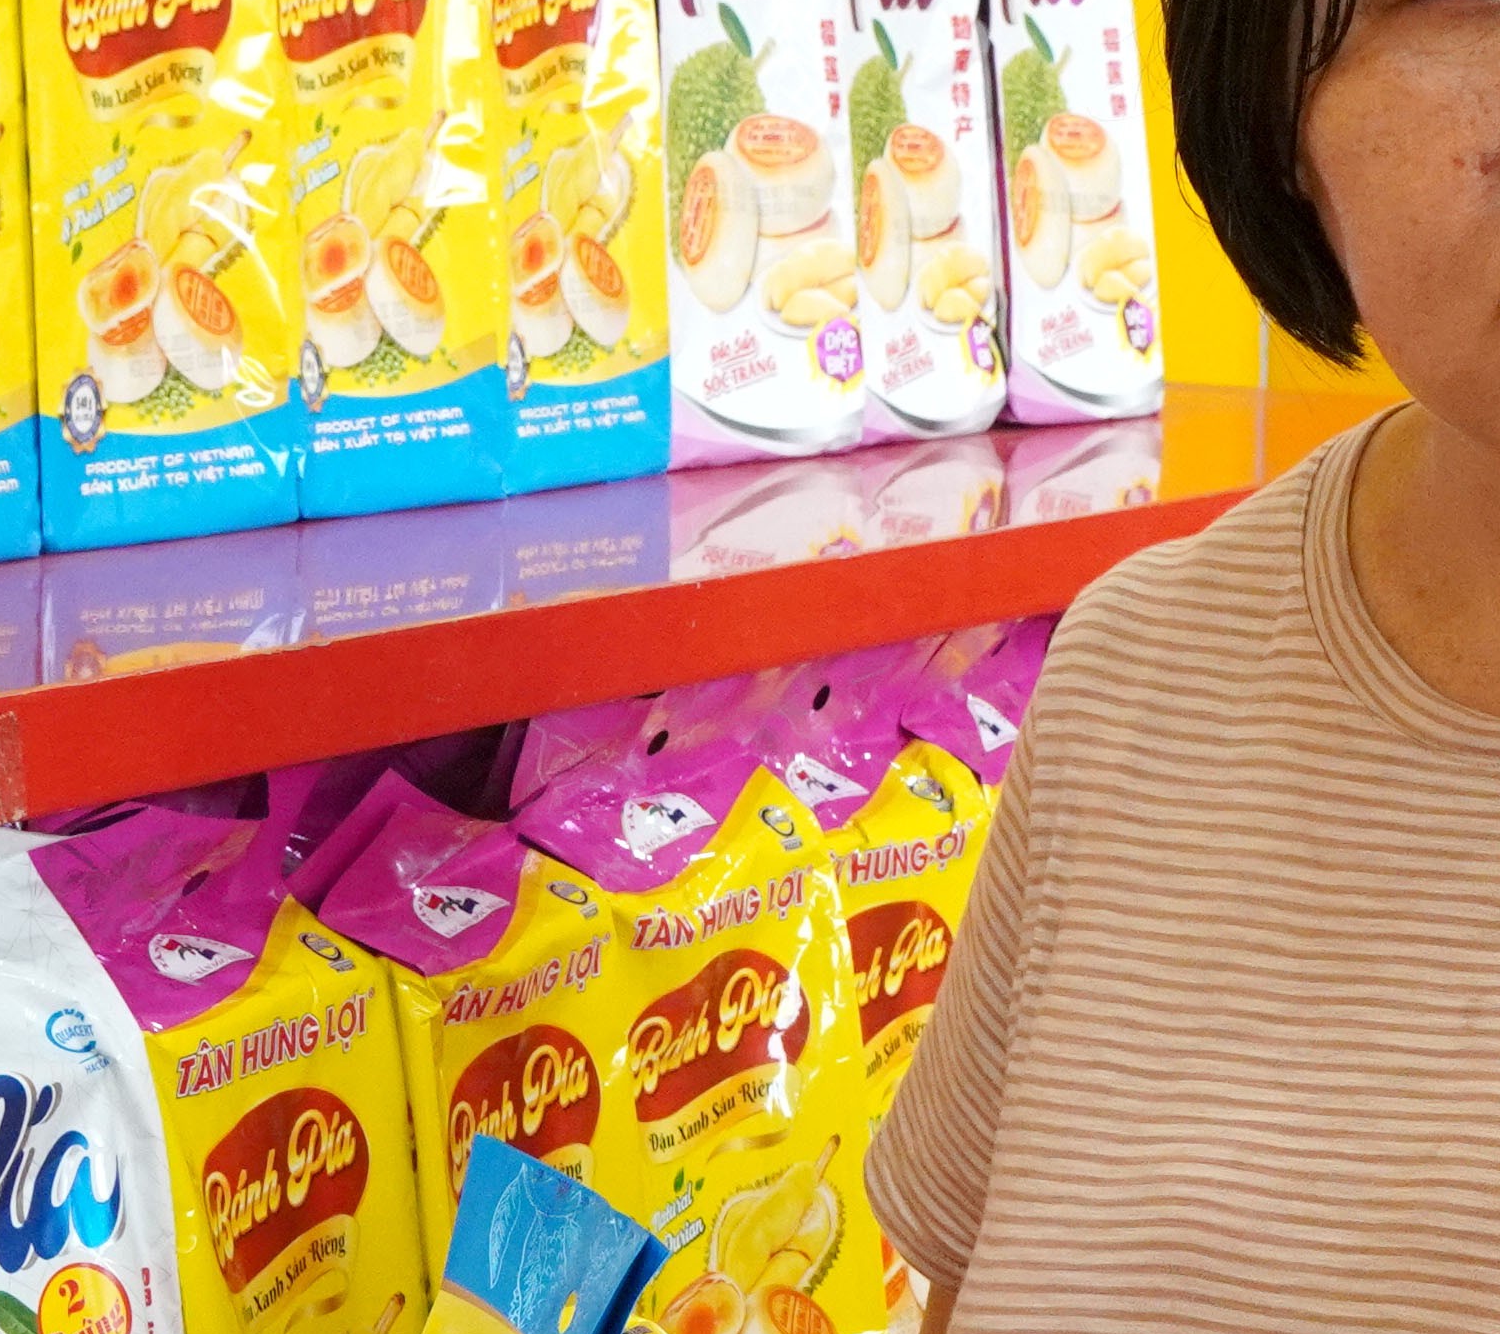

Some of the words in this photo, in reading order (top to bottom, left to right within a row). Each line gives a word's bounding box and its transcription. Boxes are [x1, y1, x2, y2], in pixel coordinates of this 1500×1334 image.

[176, 1038, 235, 1098] TÂN
[239, 1013, 320, 1079] HƯNG
[324, 996, 367, 1054] LỢI
[204, 1149, 281, 1265] Bánh
[287, 1108, 358, 1208] Pía
[58, 1279, 86, 1317] 2
[253, 1278, 285, 1313] Xanh
